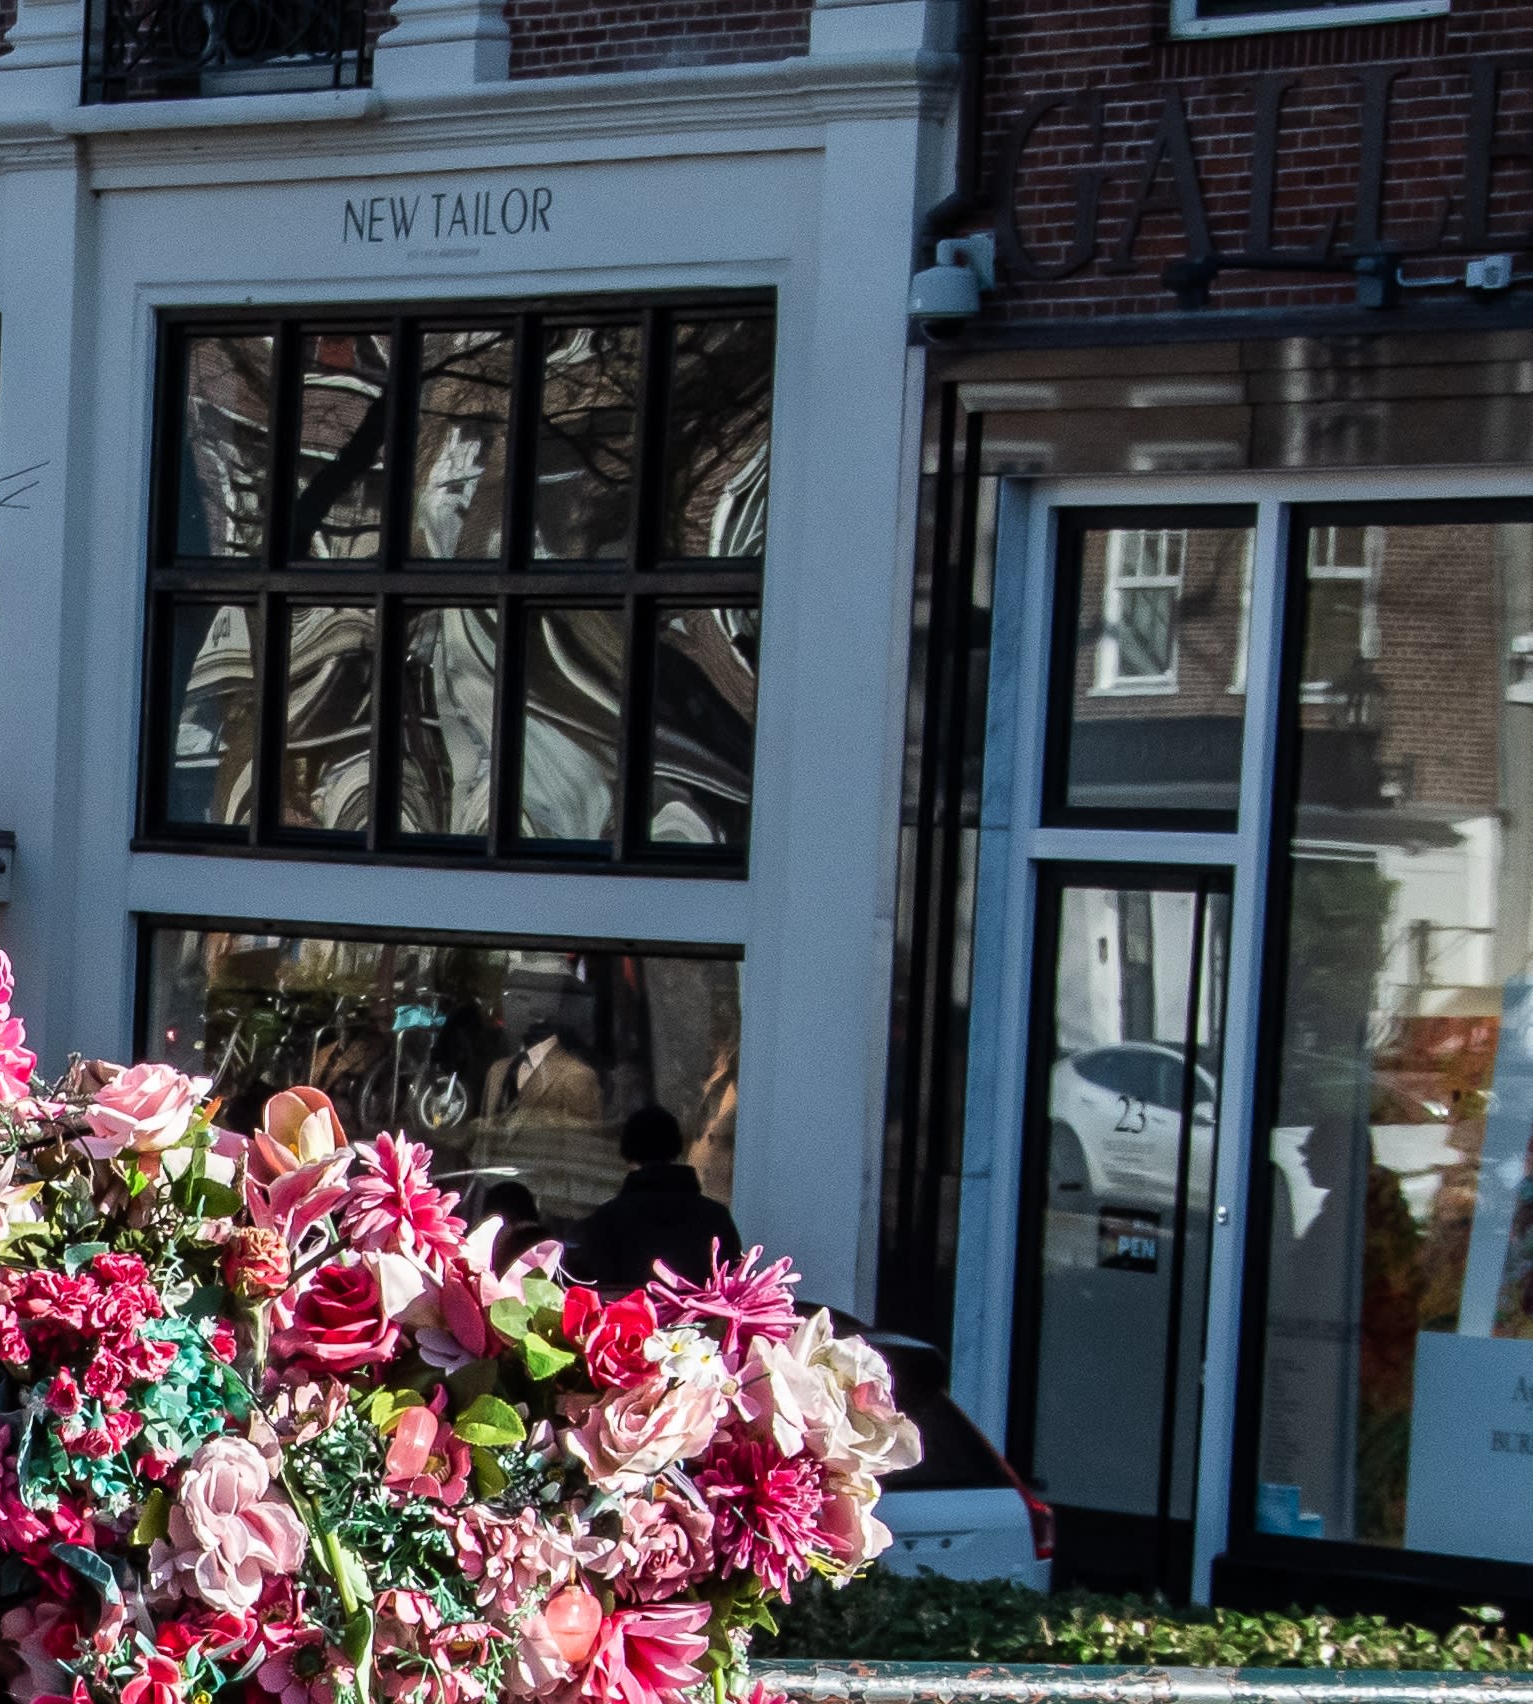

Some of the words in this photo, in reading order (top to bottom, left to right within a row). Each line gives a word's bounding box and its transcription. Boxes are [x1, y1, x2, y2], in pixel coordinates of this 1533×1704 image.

[343, 196, 420, 243] NEW
[430, 187, 552, 239] TAILOR
[1114, 1095, 1147, 1134] 23
